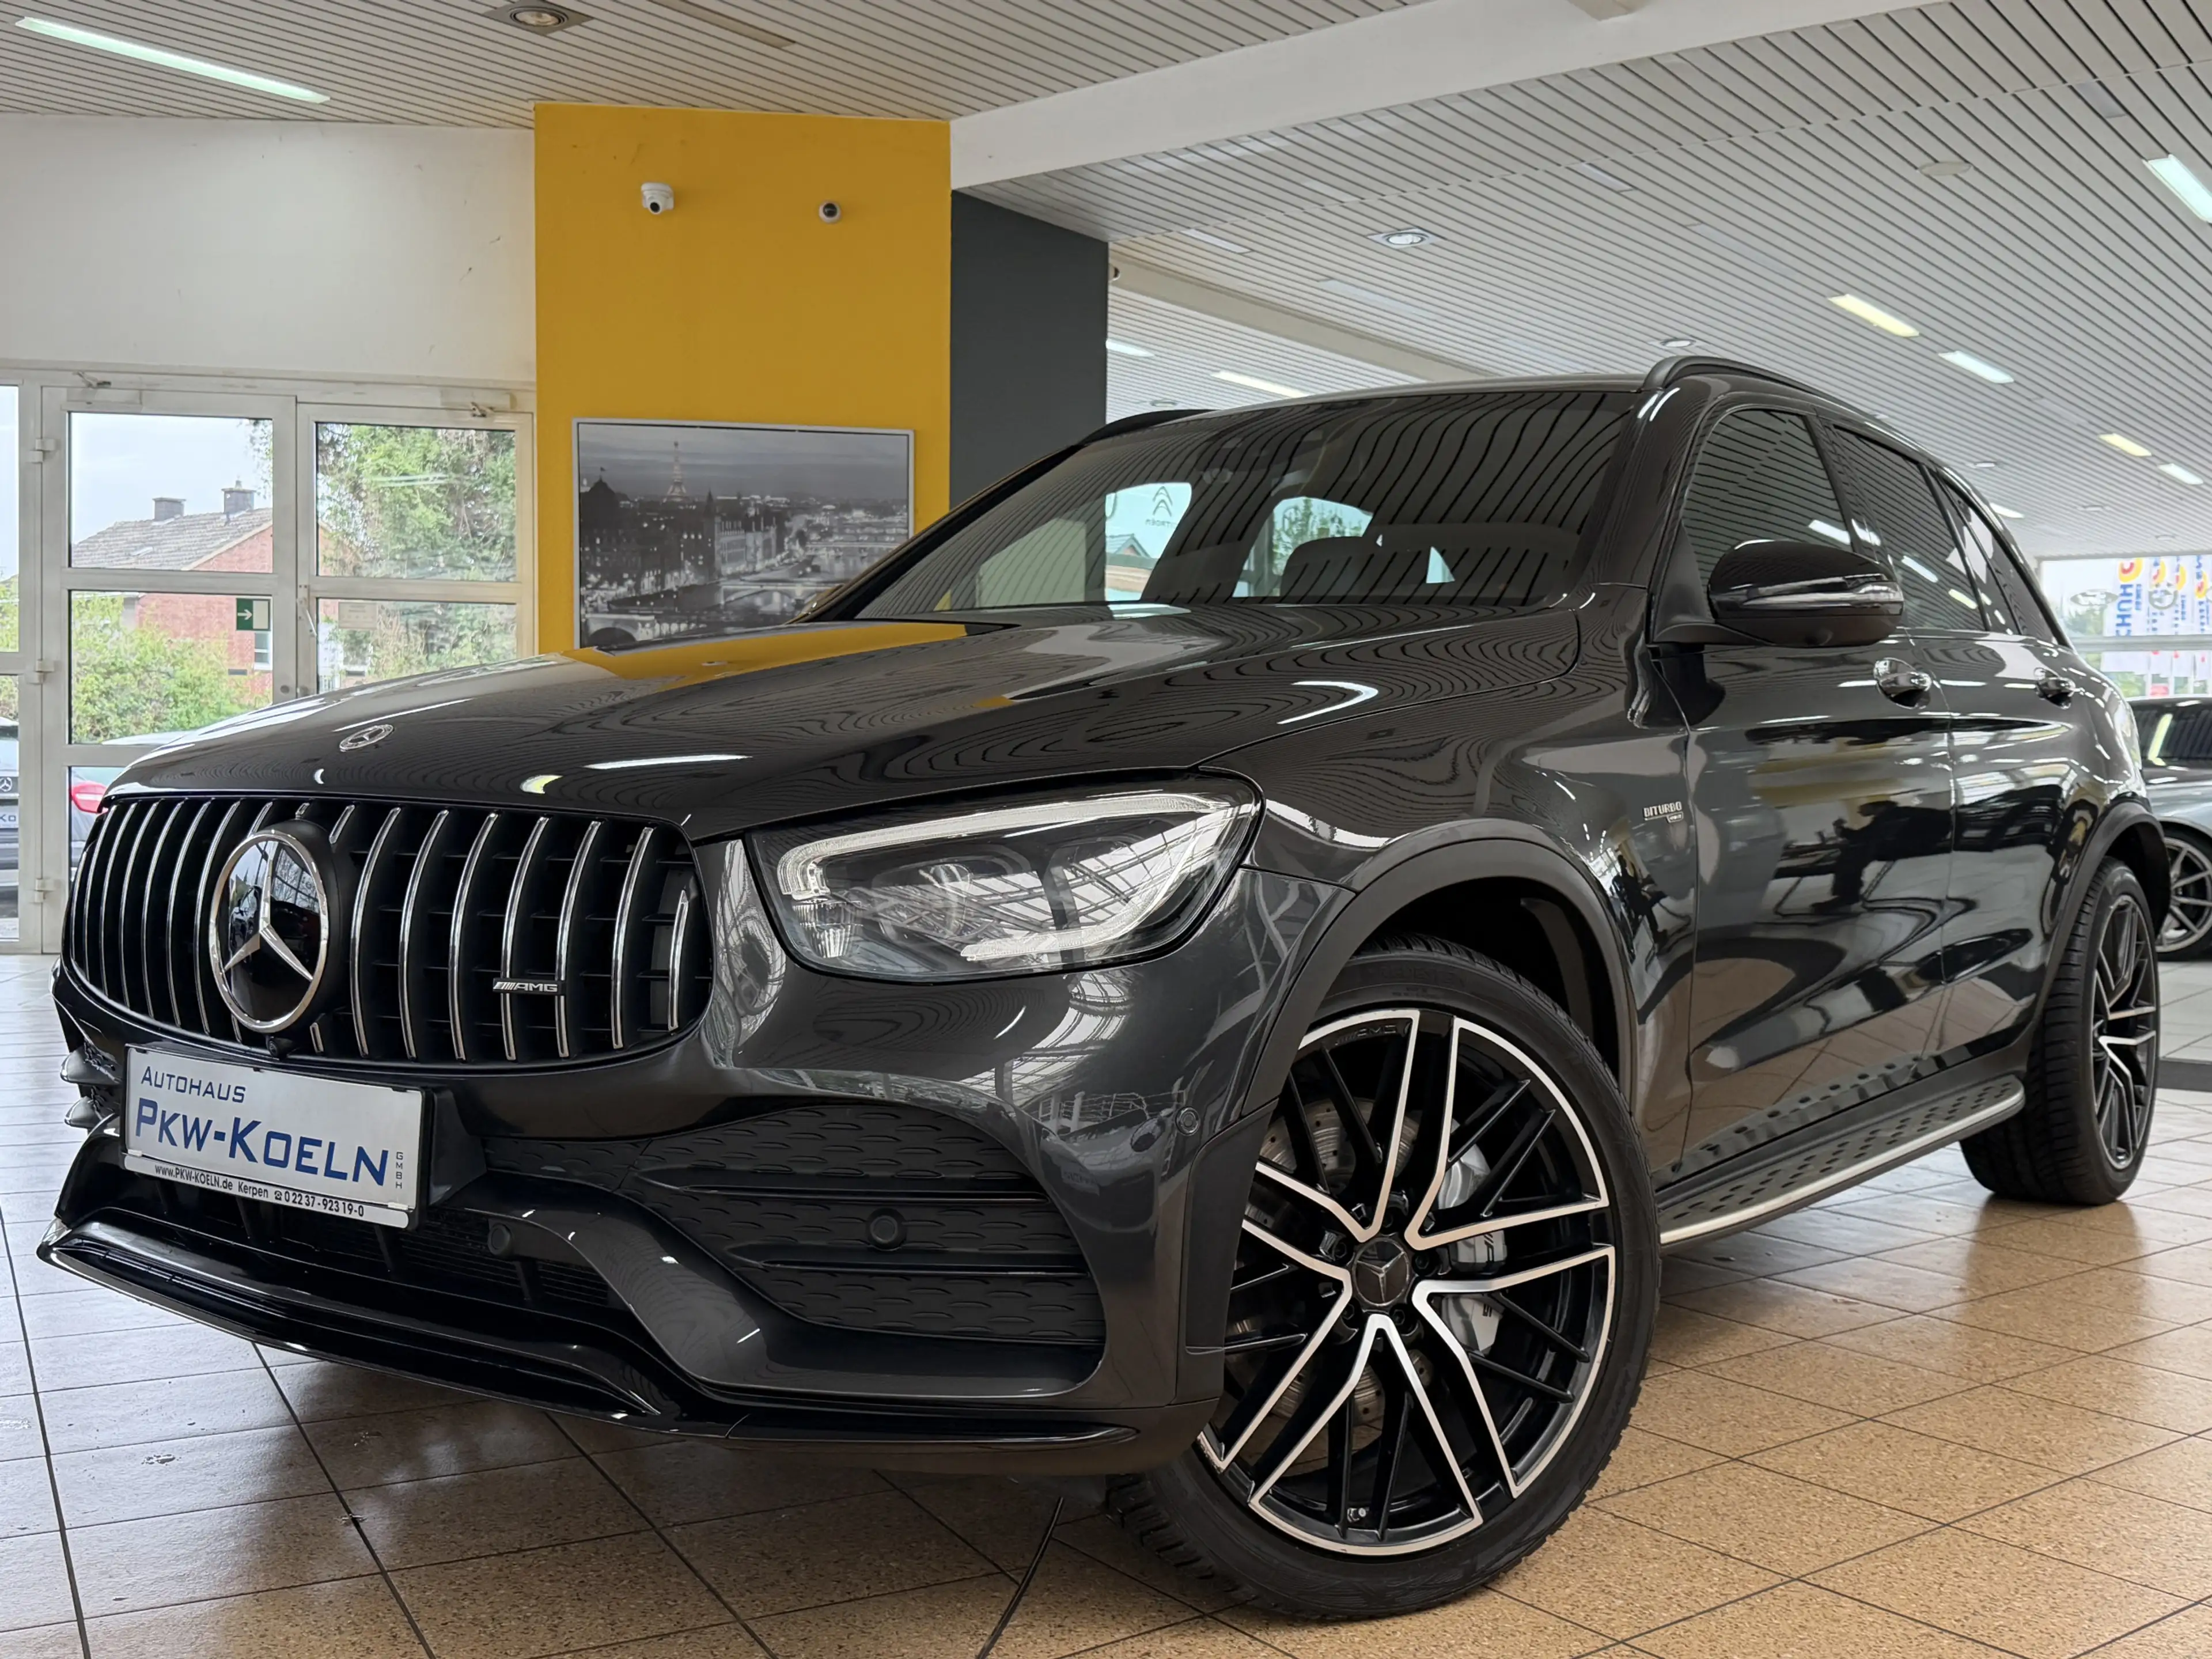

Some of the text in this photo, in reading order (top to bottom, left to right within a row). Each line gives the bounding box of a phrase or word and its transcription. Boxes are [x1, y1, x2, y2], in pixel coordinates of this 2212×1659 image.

[1643, 801, 1682, 817] BITURBO
[514, 983, 558, 992] AMG
[141, 1066, 246, 1103] AUTOHAUS
[135, 1097, 389, 1186] PKW-KOELN
[155, 1165, 233, 1191] www.PKW-KOELN.de
[238, 1181, 268, 1199] Kerpen
